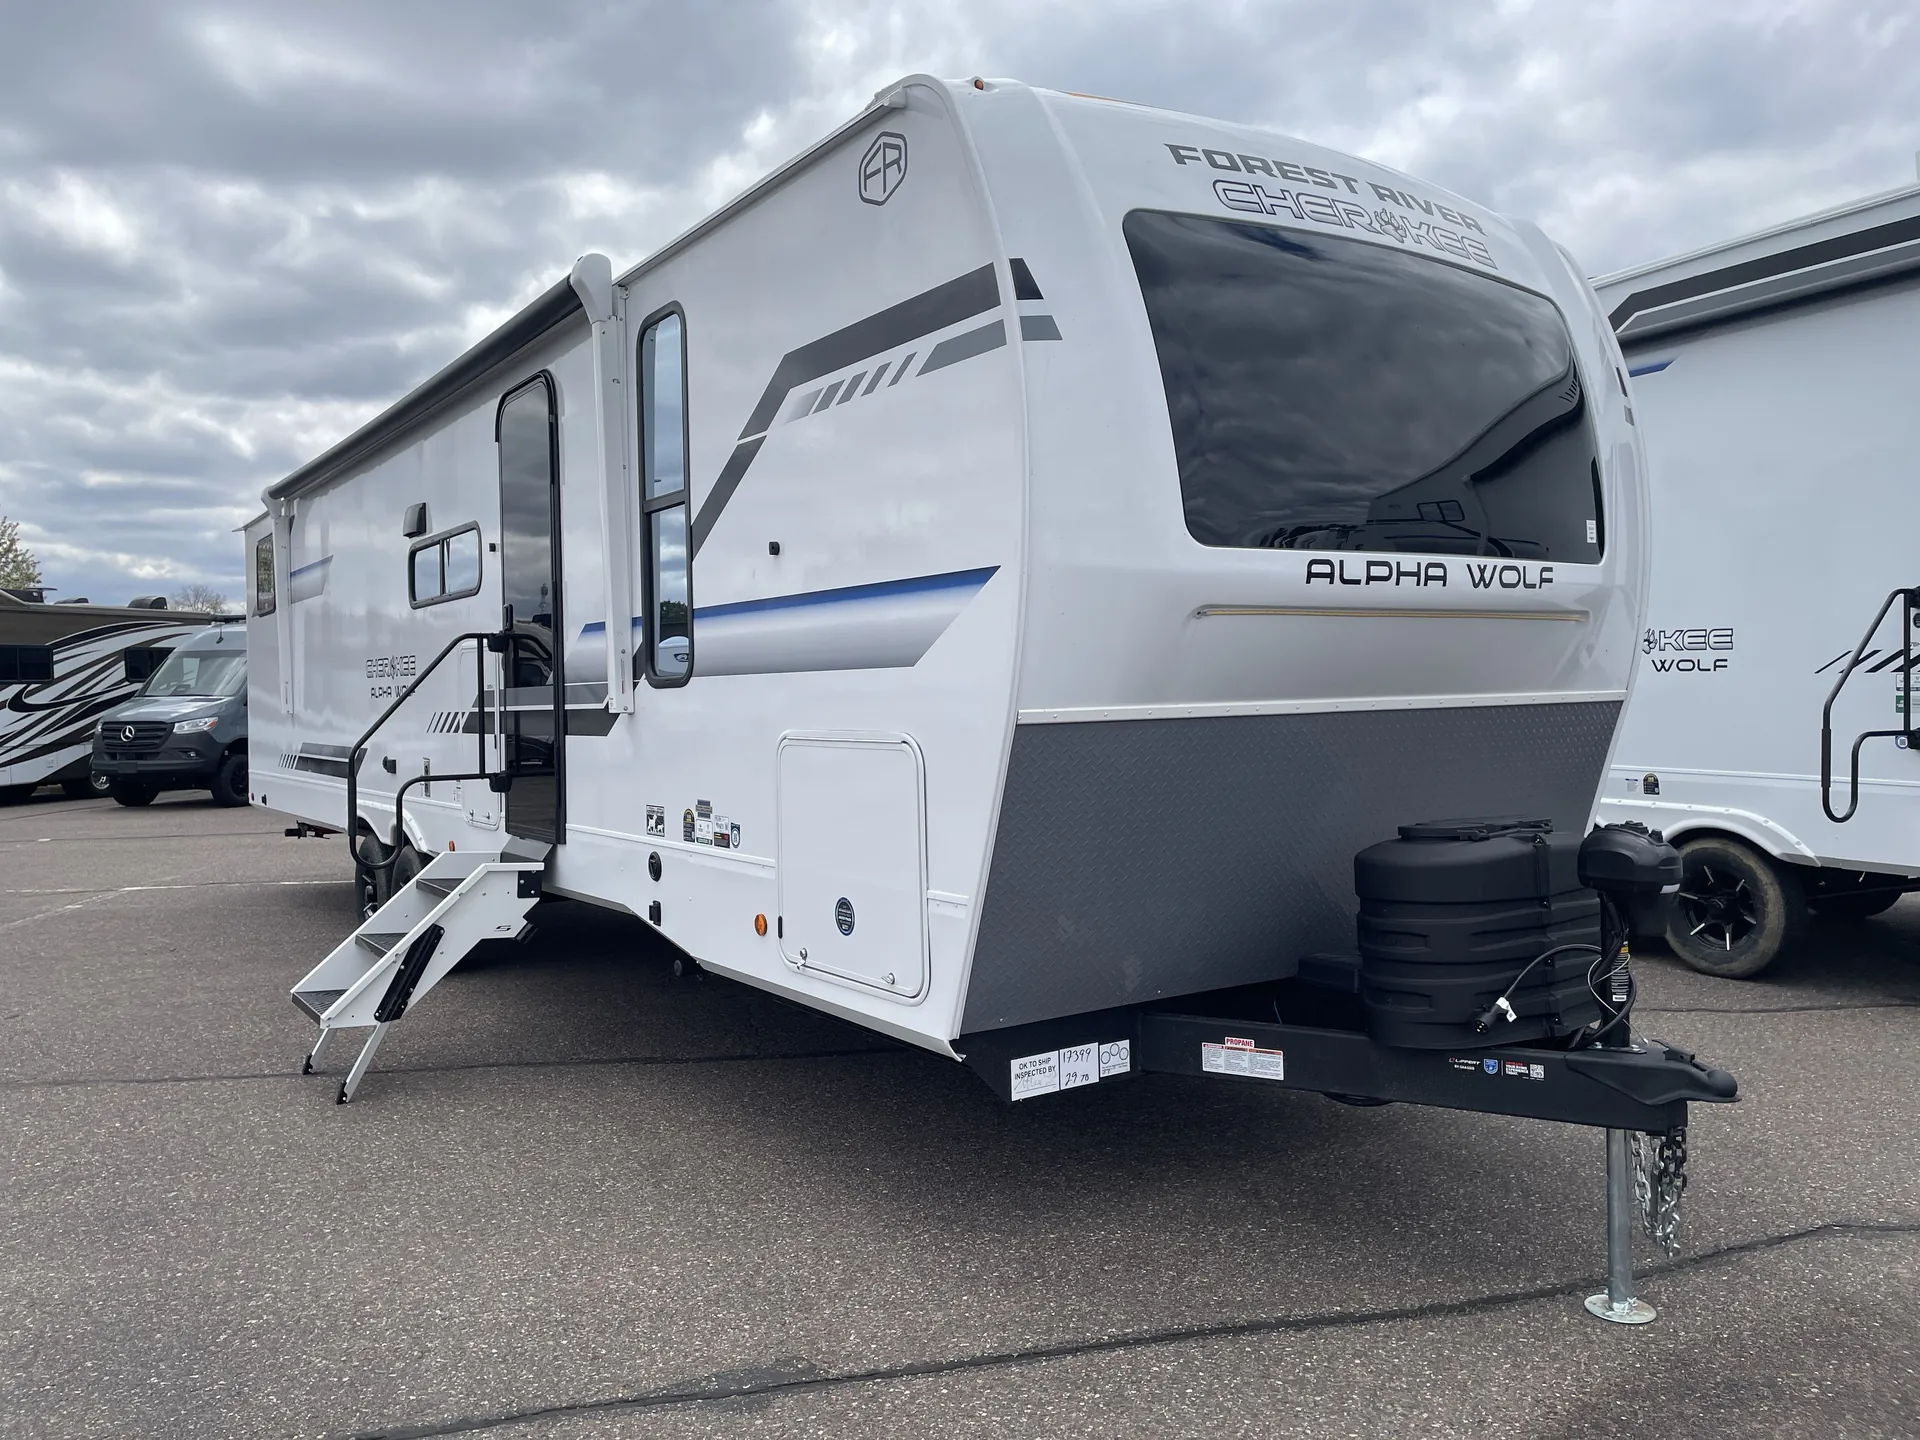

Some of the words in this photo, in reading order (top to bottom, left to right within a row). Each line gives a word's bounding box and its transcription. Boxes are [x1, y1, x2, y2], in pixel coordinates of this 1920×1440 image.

[1163, 143, 1359, 195] FOREST
[1366, 181, 1487, 237] RIVER
[1305, 558, 1448, 587] ALPHA
[1466, 562, 1554, 590] WOLF
[1651, 658, 1729, 673] WOLF
[370, 686, 392, 698] ALPHA
[394, 684, 416, 698] WO
[1226, 1038, 1253, 1047] PROPANE
[1019, 1062, 1028, 1070] OK
[1029, 1060, 1038, 1068] TO
[1038, 1057, 1052, 1066] SHIP
[1014, 1067, 1047, 1080] INSPECTED
